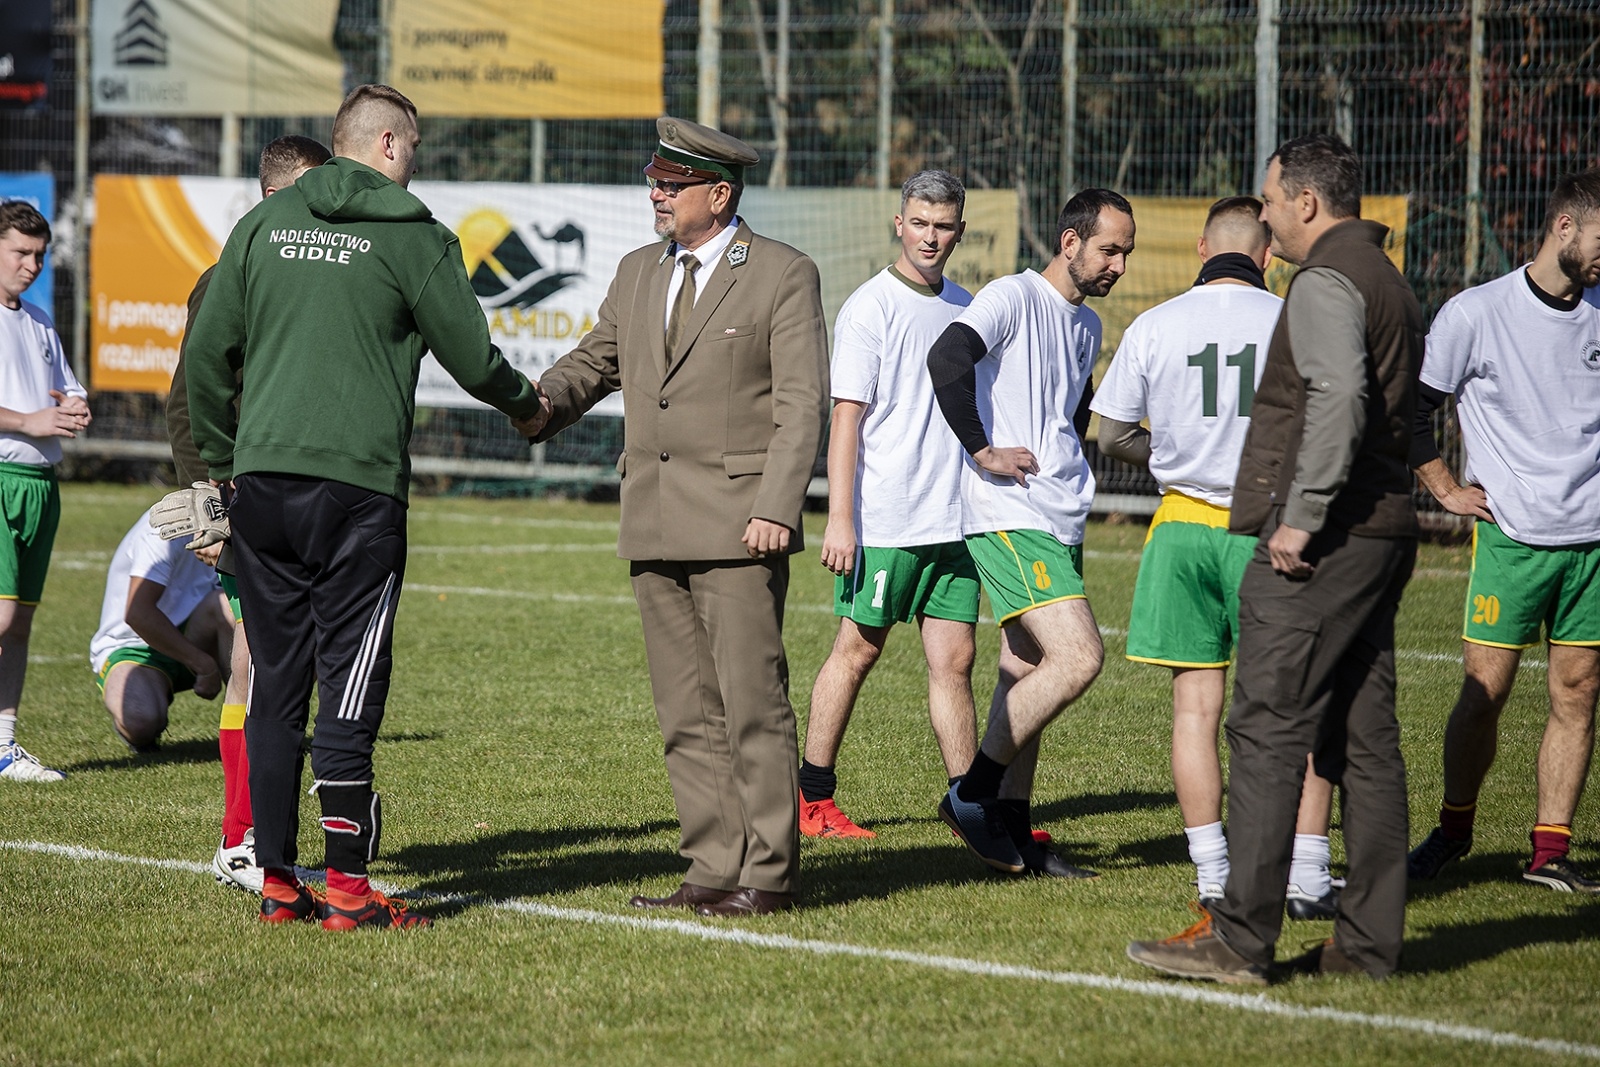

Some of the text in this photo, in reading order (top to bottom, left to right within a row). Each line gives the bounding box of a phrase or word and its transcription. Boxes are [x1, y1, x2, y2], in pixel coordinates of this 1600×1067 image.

[269, 227, 371, 253] NADLEŚNICTWO
[279, 245, 353, 265] GIDLE
[1187, 343, 1257, 417] 11
[871, 569, 888, 609] 1
[1032, 560, 1051, 590] 8
[1471, 593, 1501, 626] 20
